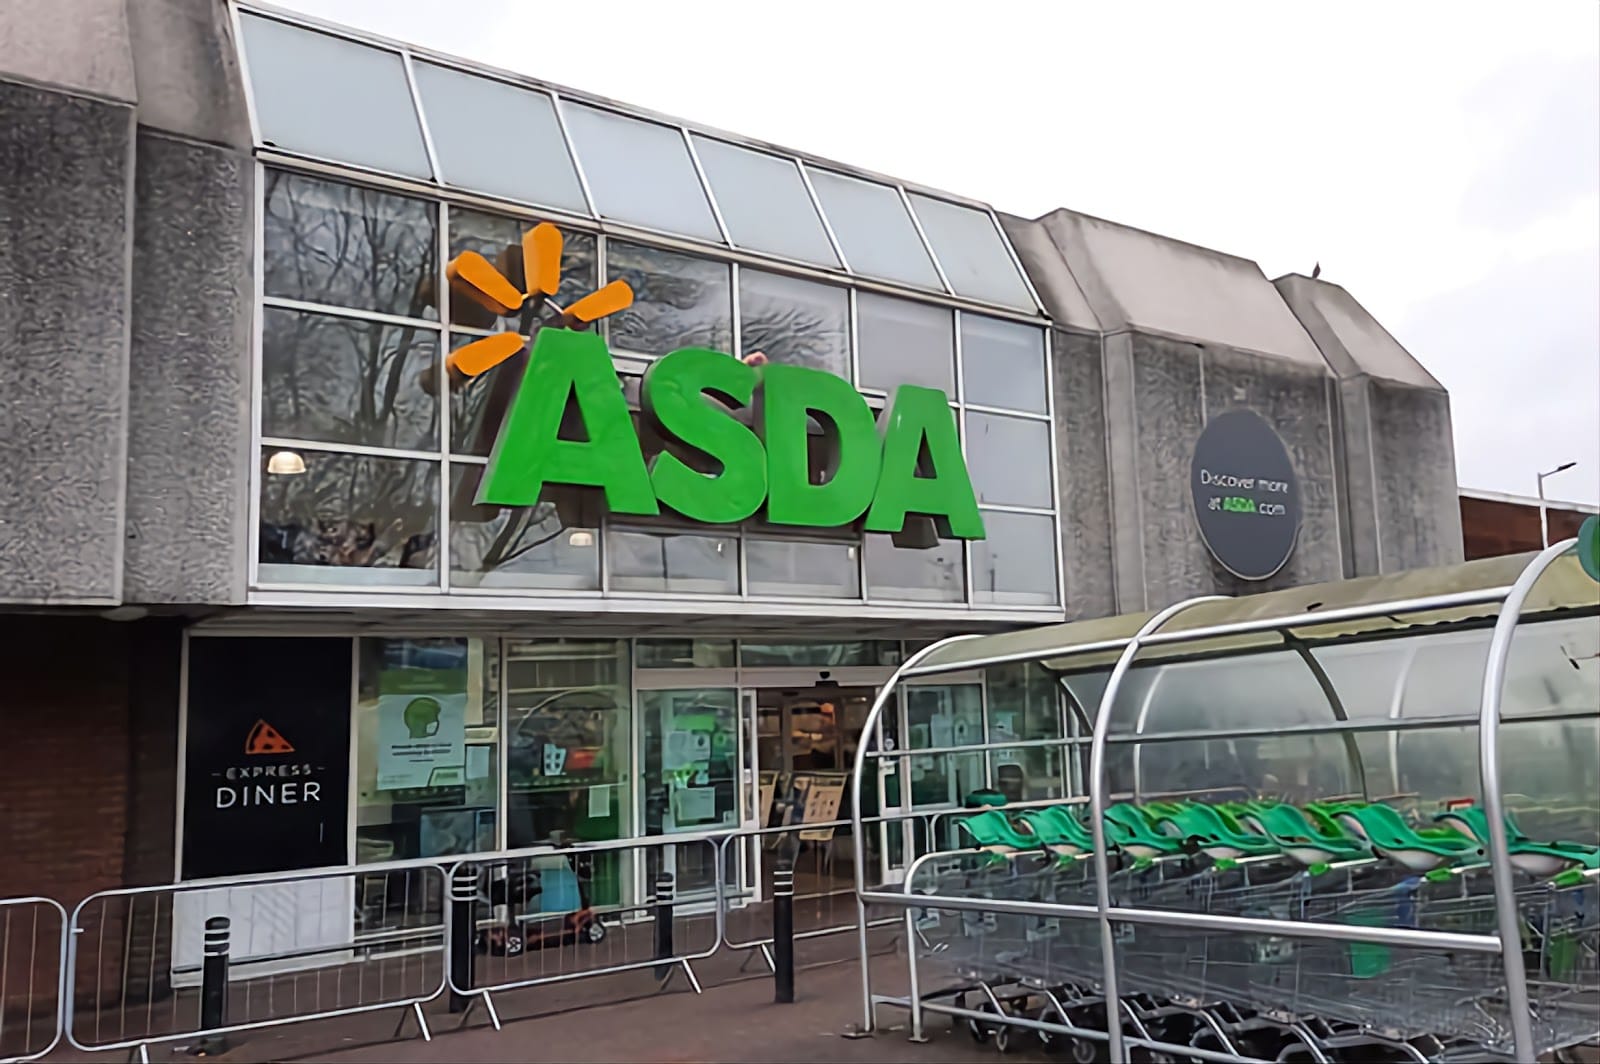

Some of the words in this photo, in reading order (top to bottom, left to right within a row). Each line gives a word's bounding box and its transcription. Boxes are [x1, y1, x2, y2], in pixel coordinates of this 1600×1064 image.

[475, 326, 986, 540] ASDA
[226, 764, 312, 780] EXPRESS
[216, 781, 321, 808] DINER
